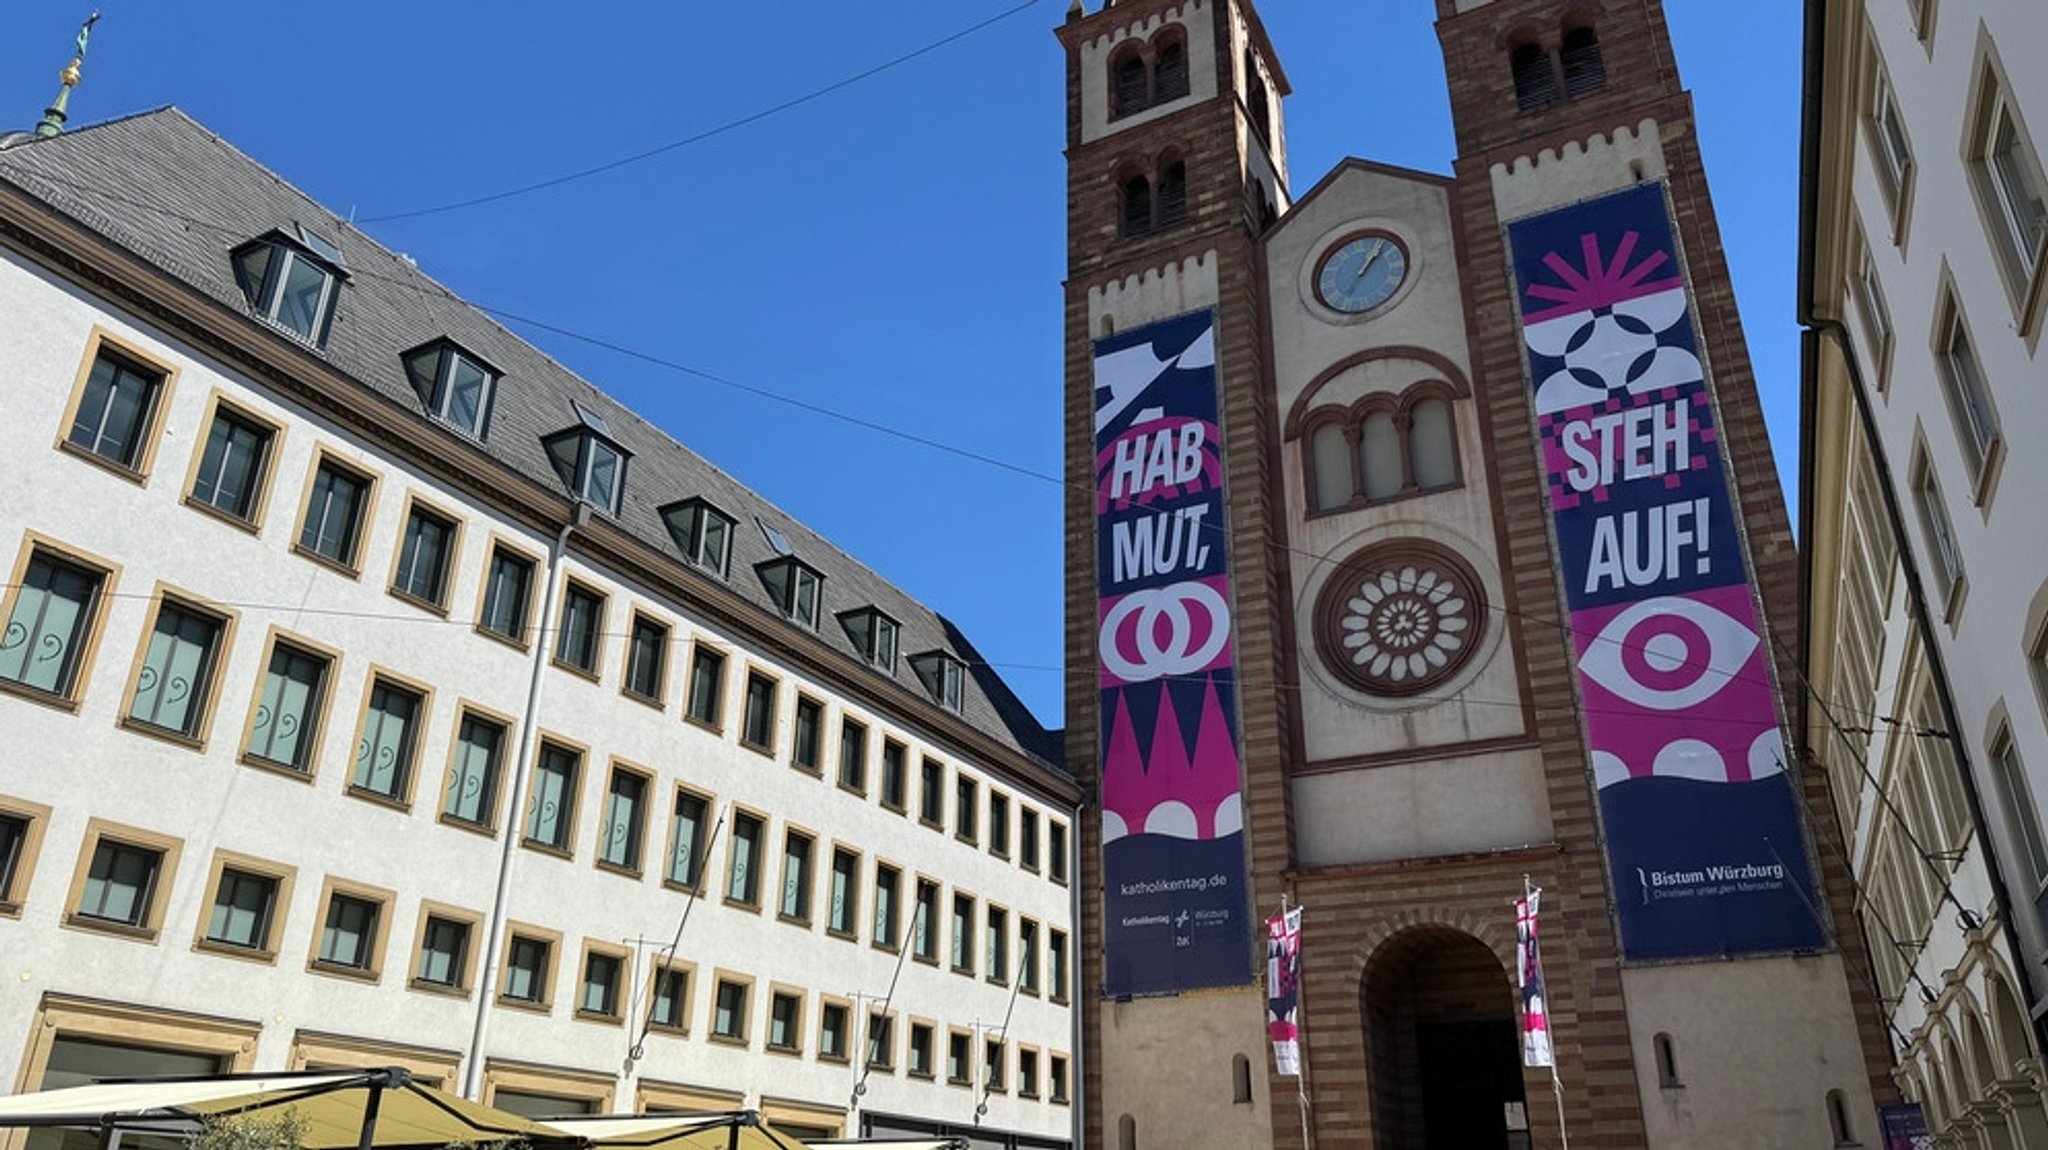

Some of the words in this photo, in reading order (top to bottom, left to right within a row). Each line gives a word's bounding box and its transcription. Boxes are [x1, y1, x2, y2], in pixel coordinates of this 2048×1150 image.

[1110, 421, 1205, 499] HAB
[1562, 398, 1689, 492] STEH
[1112, 503, 1211, 583] MUT,
[1584, 497, 1711, 594] AUF!
[1121, 873, 1228, 895] katholikentag.de
[1651, 870, 1704, 886] Bistum
[1706, 864, 1784, 880] Würzburg
